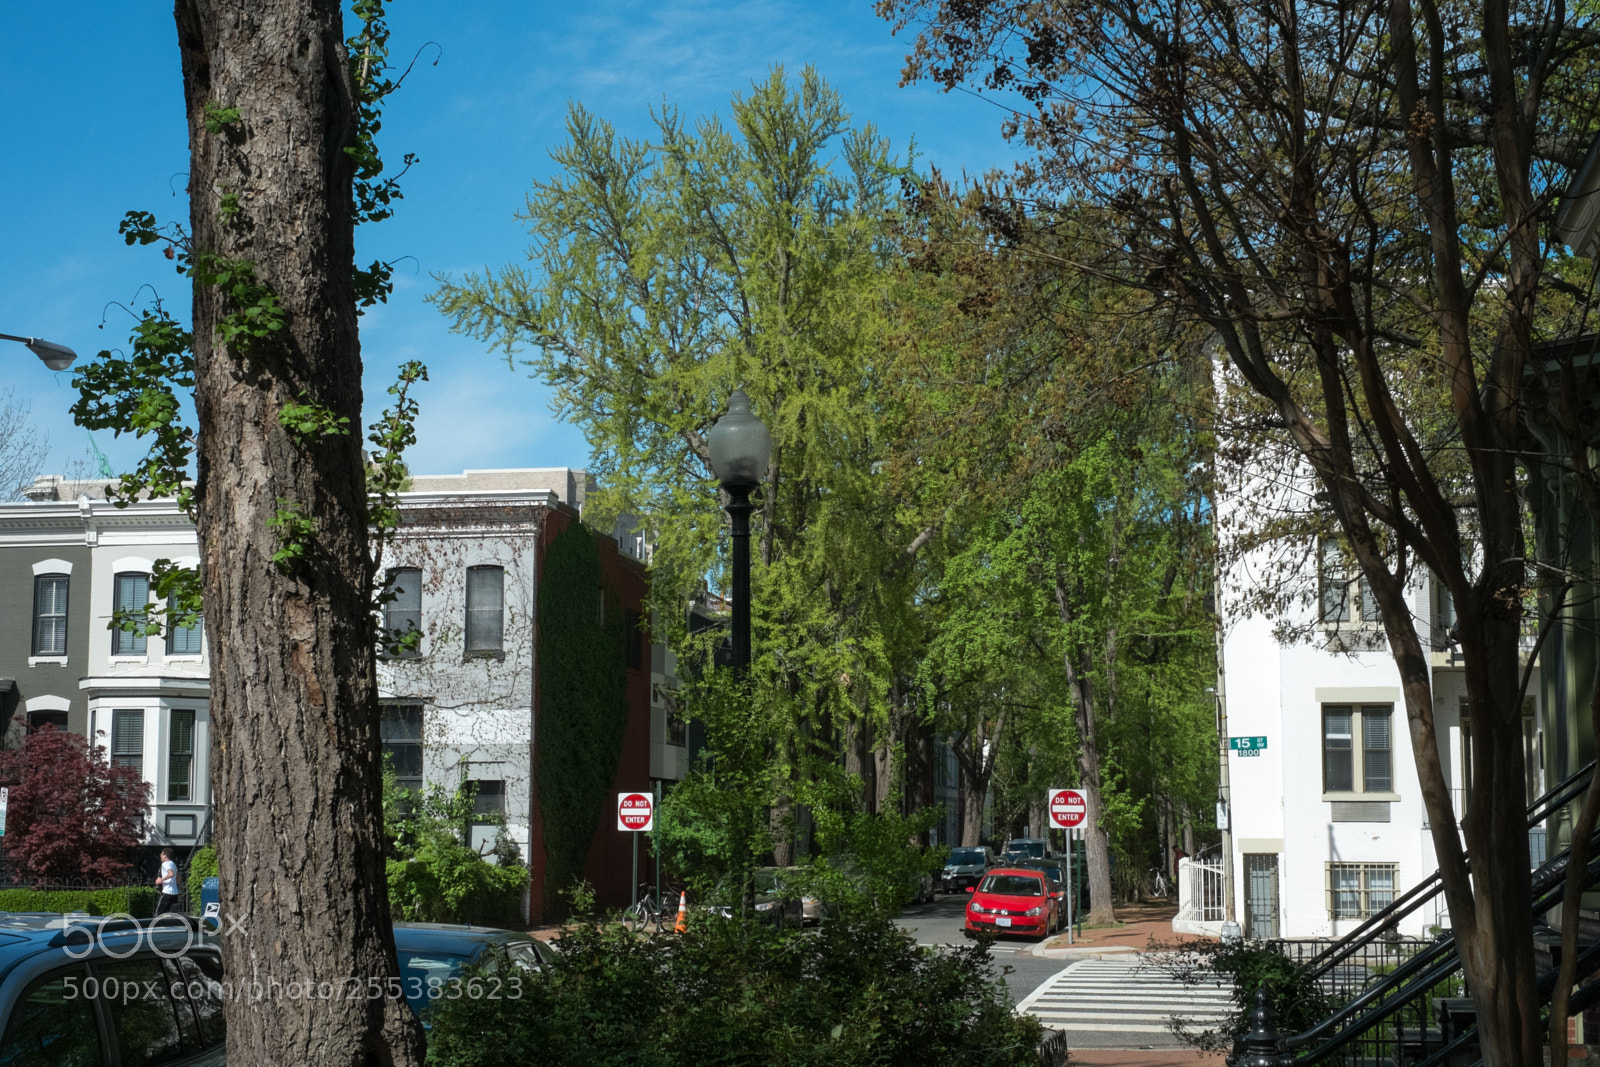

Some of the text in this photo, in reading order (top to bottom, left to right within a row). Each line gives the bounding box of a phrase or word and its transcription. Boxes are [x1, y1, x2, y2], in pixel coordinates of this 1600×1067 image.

[1235, 738, 1251, 749] 15
[625, 816, 645, 824] ENTER
[1057, 813, 1079, 821] ENTER
